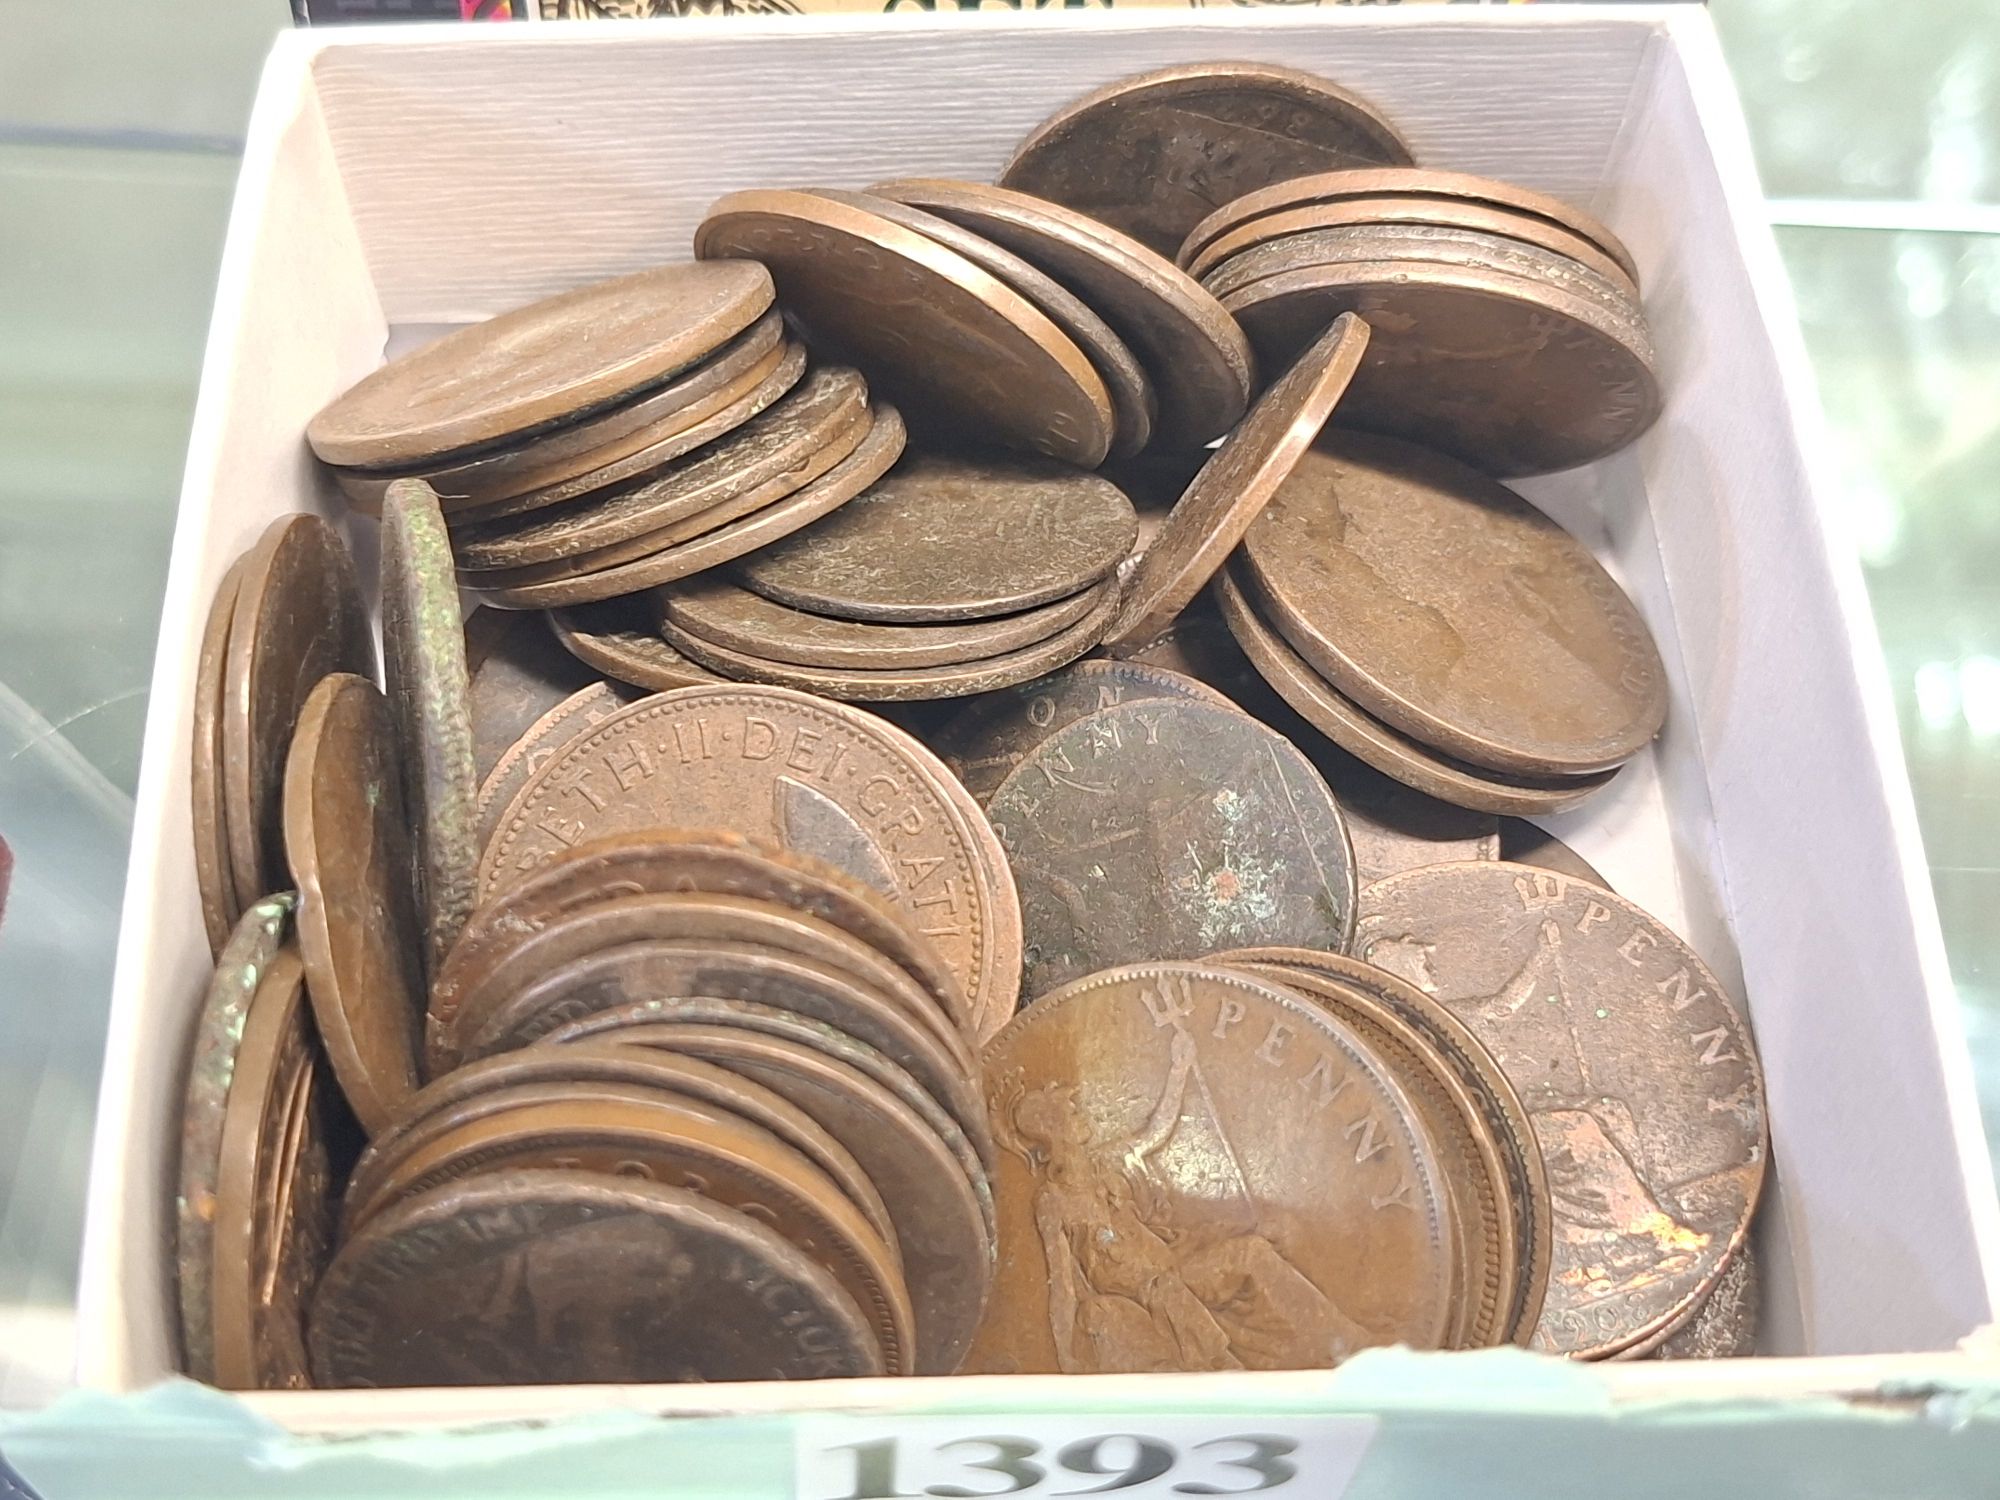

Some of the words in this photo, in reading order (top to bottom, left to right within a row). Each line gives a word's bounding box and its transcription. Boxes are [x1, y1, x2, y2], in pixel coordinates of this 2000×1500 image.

[1211, 998, 1414, 1211] PENNY
[1576, 899, 1757, 1120] PENNY
[820, 1433, 1302, 1500] 1393
